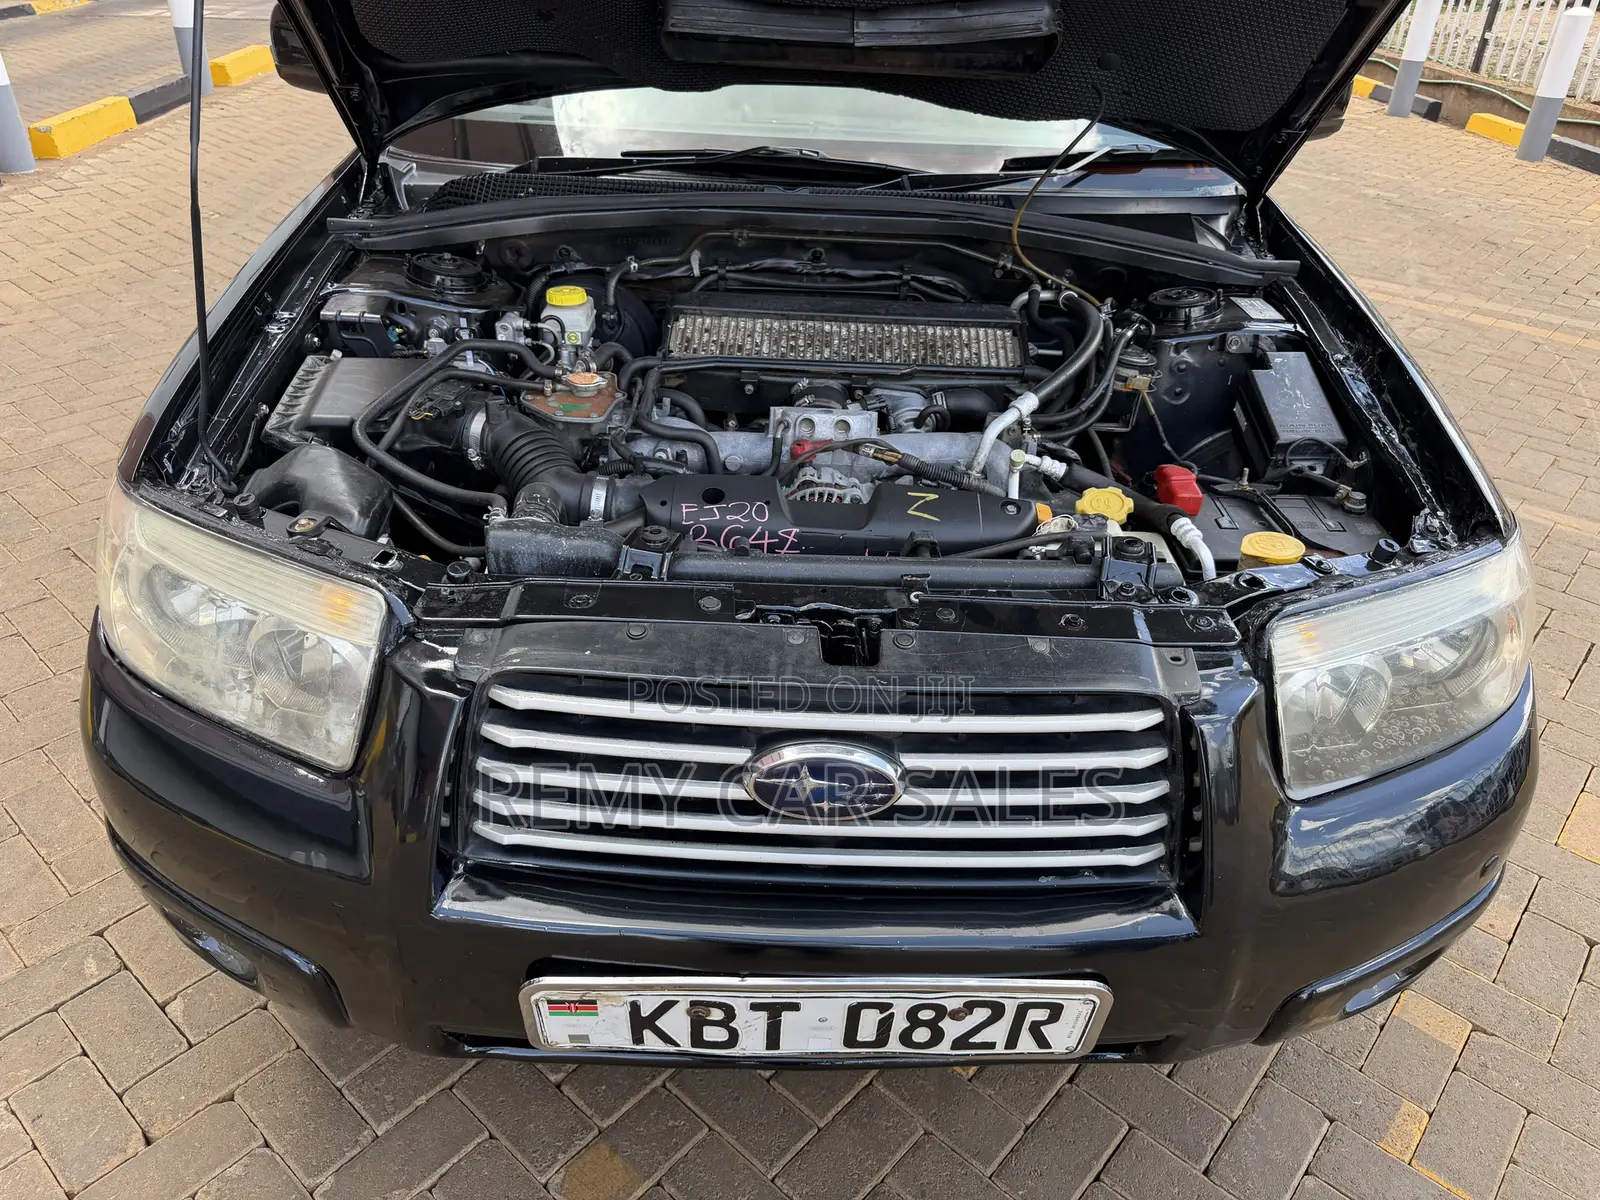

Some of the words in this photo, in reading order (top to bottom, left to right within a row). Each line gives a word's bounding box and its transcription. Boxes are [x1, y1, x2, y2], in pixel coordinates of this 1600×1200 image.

[680, 500, 770, 525] EJ20
[628, 999, 802, 1051] KBT
[842, 999, 1065, 1051] 082R
